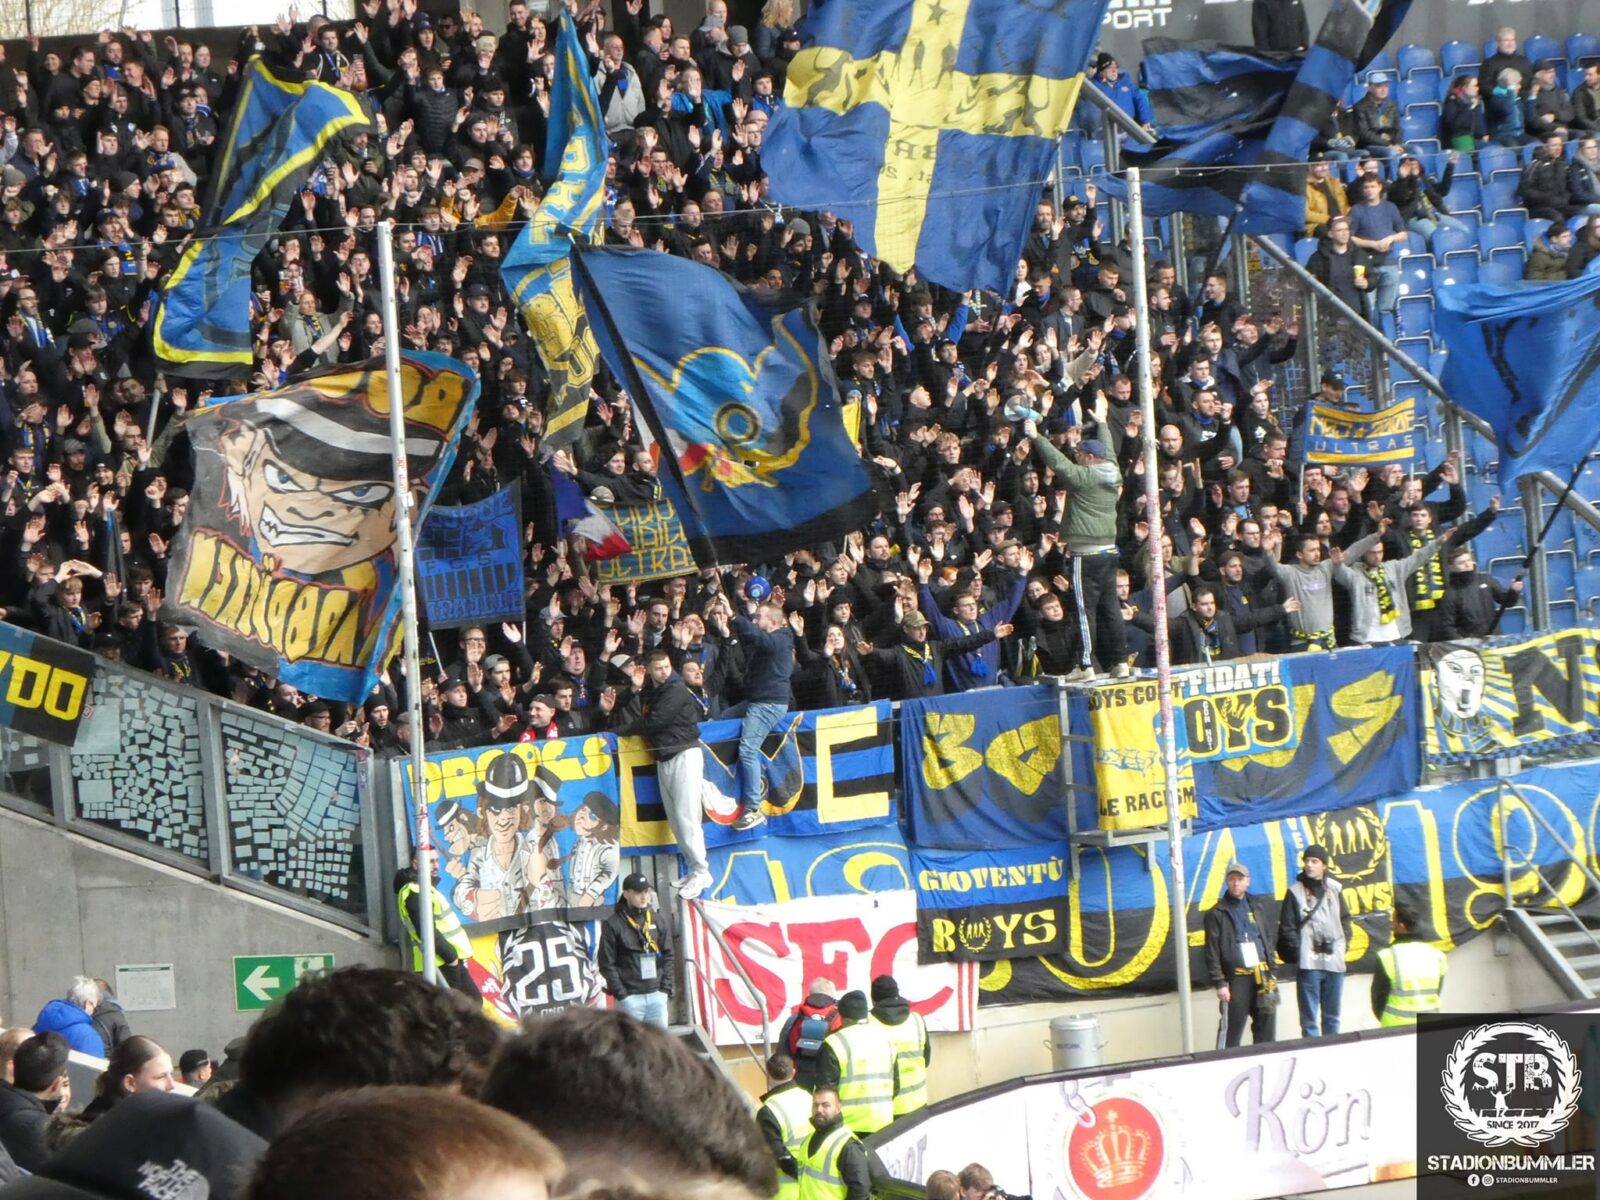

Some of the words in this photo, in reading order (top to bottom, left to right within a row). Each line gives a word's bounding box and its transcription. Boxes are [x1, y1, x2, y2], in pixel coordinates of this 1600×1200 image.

[1314, 434, 1413, 454] ULTRAS
[597, 545, 694, 577] ULTRA
[0, 649, 88, 721] DO
[918, 855, 1064, 893] GIOVENTÙ
[1342, 881, 1393, 916] OYS
[513, 935, 583, 1008] 25
[1224, 1057, 1372, 1156] Kön
